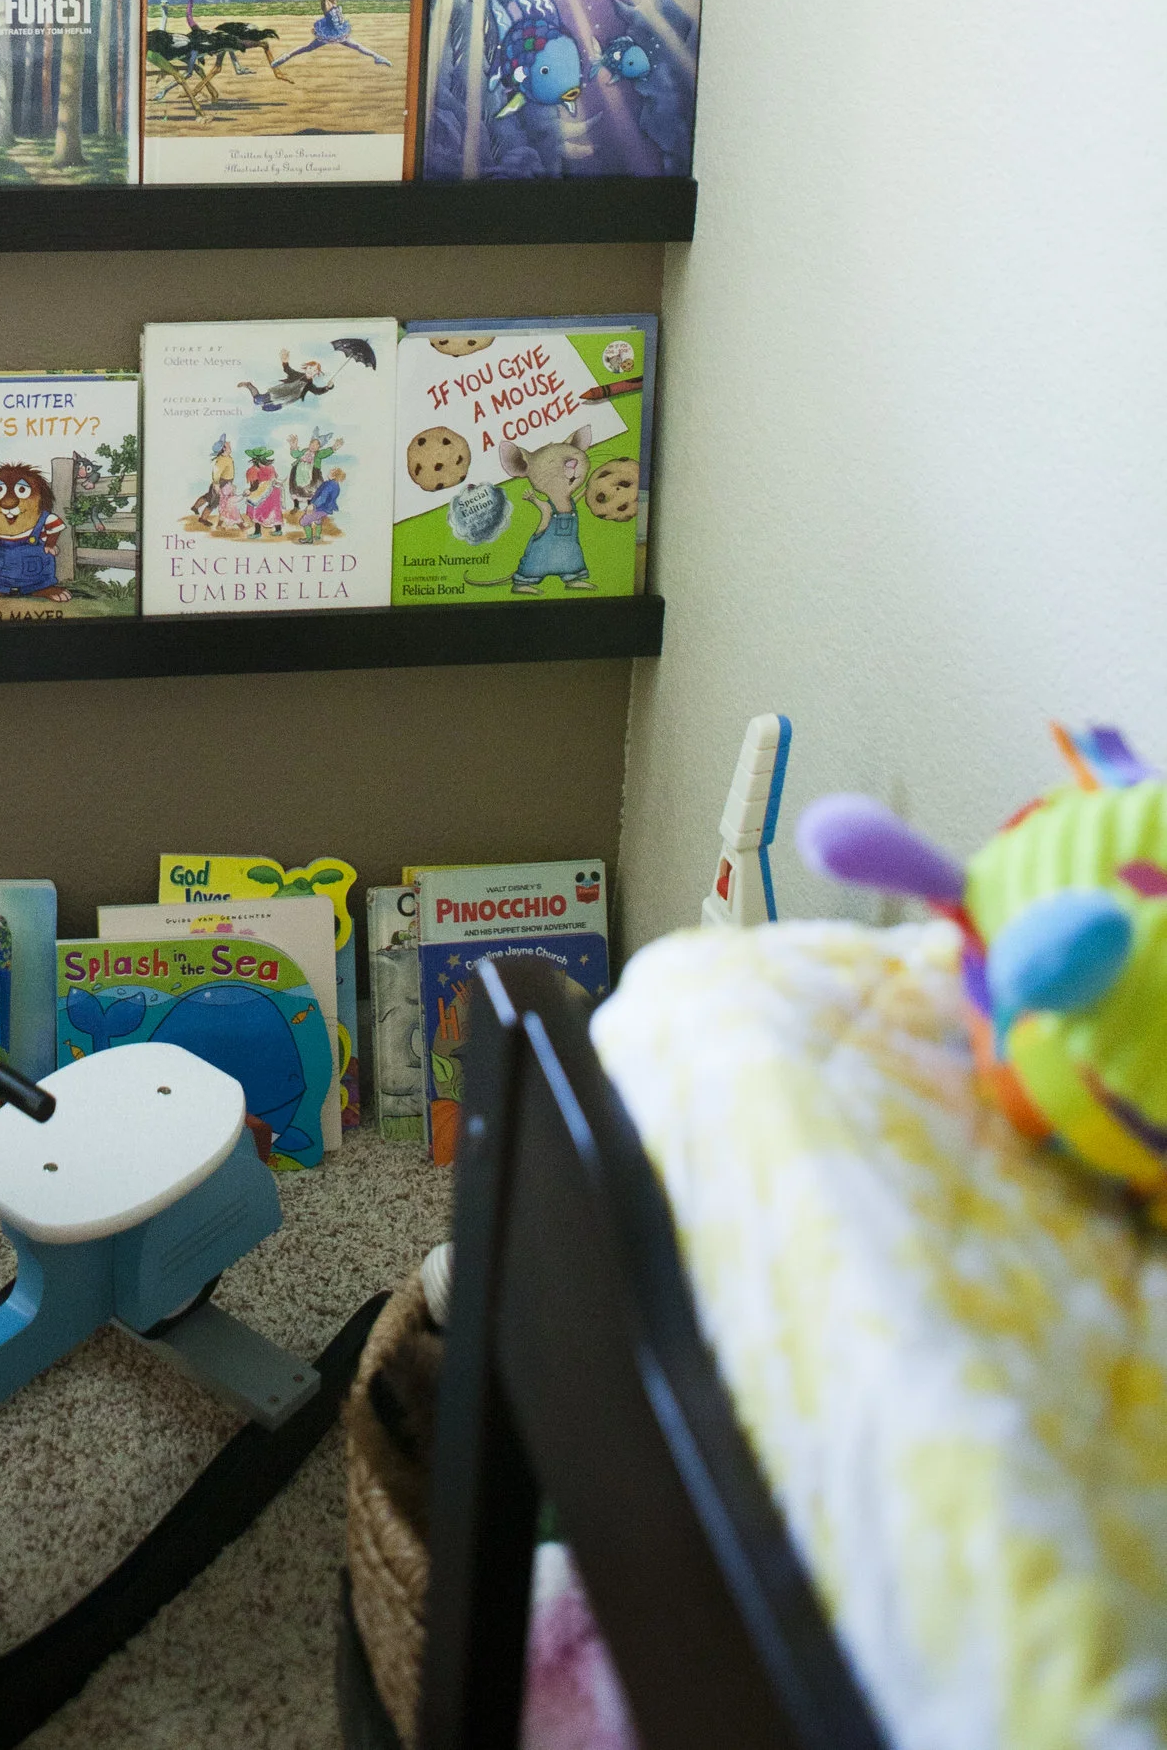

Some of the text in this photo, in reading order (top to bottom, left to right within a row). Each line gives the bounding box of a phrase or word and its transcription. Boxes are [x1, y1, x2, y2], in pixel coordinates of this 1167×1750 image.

[47, 27, 63, 35] TOM
[65, 27, 92, 35] HEFLIN
[163, 356, 242, 368] Odette Meyers
[426, 344, 551, 410] IF YOU GIVE
[473, 370, 565, 423] A MOUSE
[163, 408, 199, 418] Margot
[482, 391, 580, 452] A COOKIE
[26, 416, 101, 437] KITTY?
[458, 489, 489, 509] Special
[461, 499, 494, 518] Edition
[162, 534, 196, 550] The
[170, 554, 358, 577] ENCHANTED
[403, 553, 492, 567] Laura Numeroff
[178, 581, 350, 604] UMBRELLA
[402, 583, 465, 596] Felicia Bond
[9, 609, 64, 622] MAYER
[170, 860, 210, 886] God
[486, 883, 542, 894] WALT DISNEY'S
[436, 894, 567, 923] PINOCCHIO
[464, 922, 587, 937] AND HIS PUPPET SHOW ADVENTURE
[64, 944, 280, 984] Splash in the Sea
[505, 946, 534, 957] Jayne
[535, 946, 568, 965] Church
